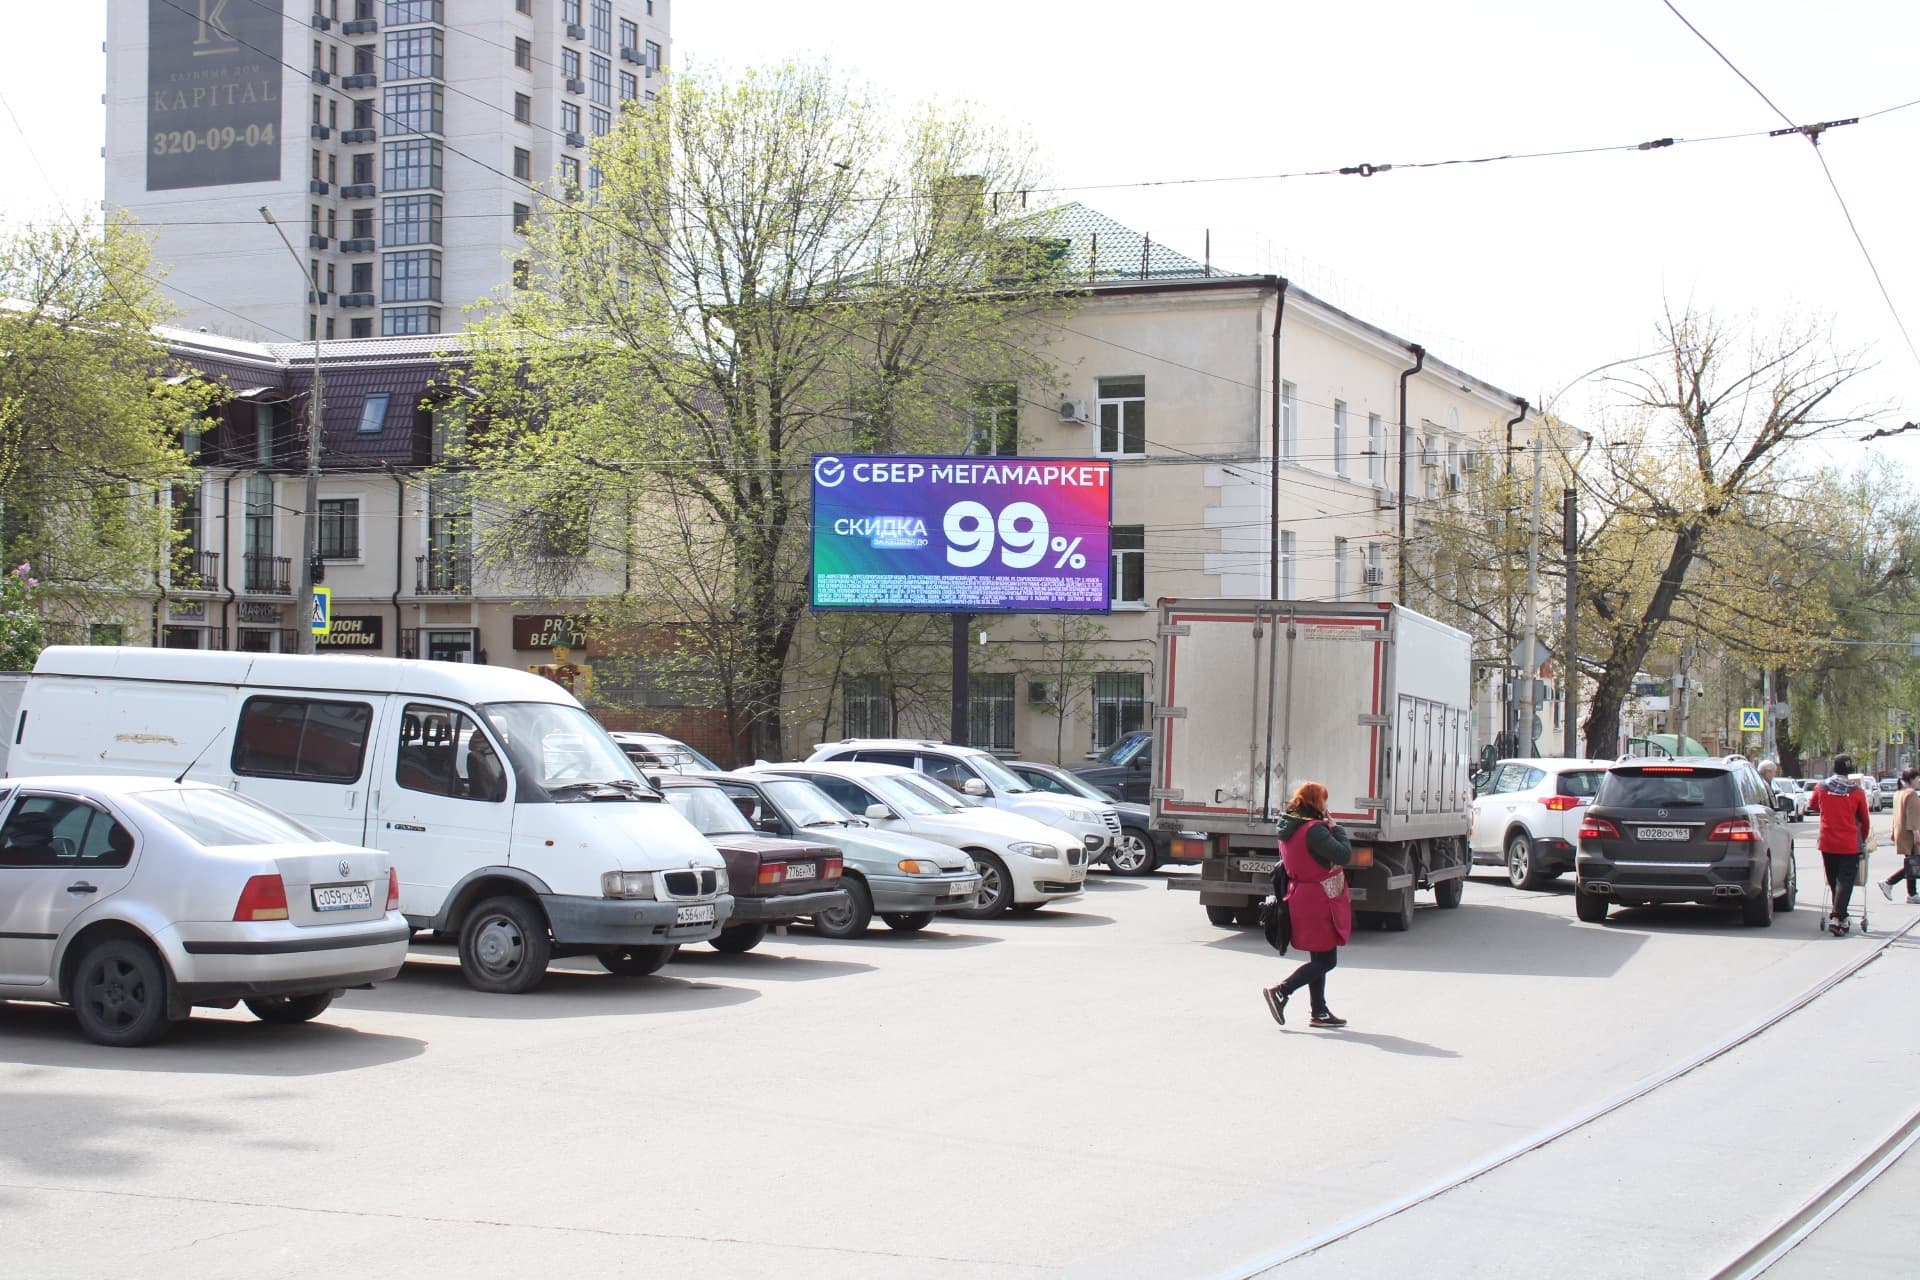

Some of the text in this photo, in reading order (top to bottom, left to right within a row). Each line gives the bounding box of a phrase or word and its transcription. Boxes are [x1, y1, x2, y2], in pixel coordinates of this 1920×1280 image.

[152, 80, 277, 112] KAPITAL
[153, 123, 275, 155] 320-09-04
[852, 463, 1110, 487] СБЕР МЕГАМАРКЕТ
[834, 518, 928, 538] СКИДКА
[543, 618, 574, 632] PRO
[530, 632, 587, 646] BEATY
